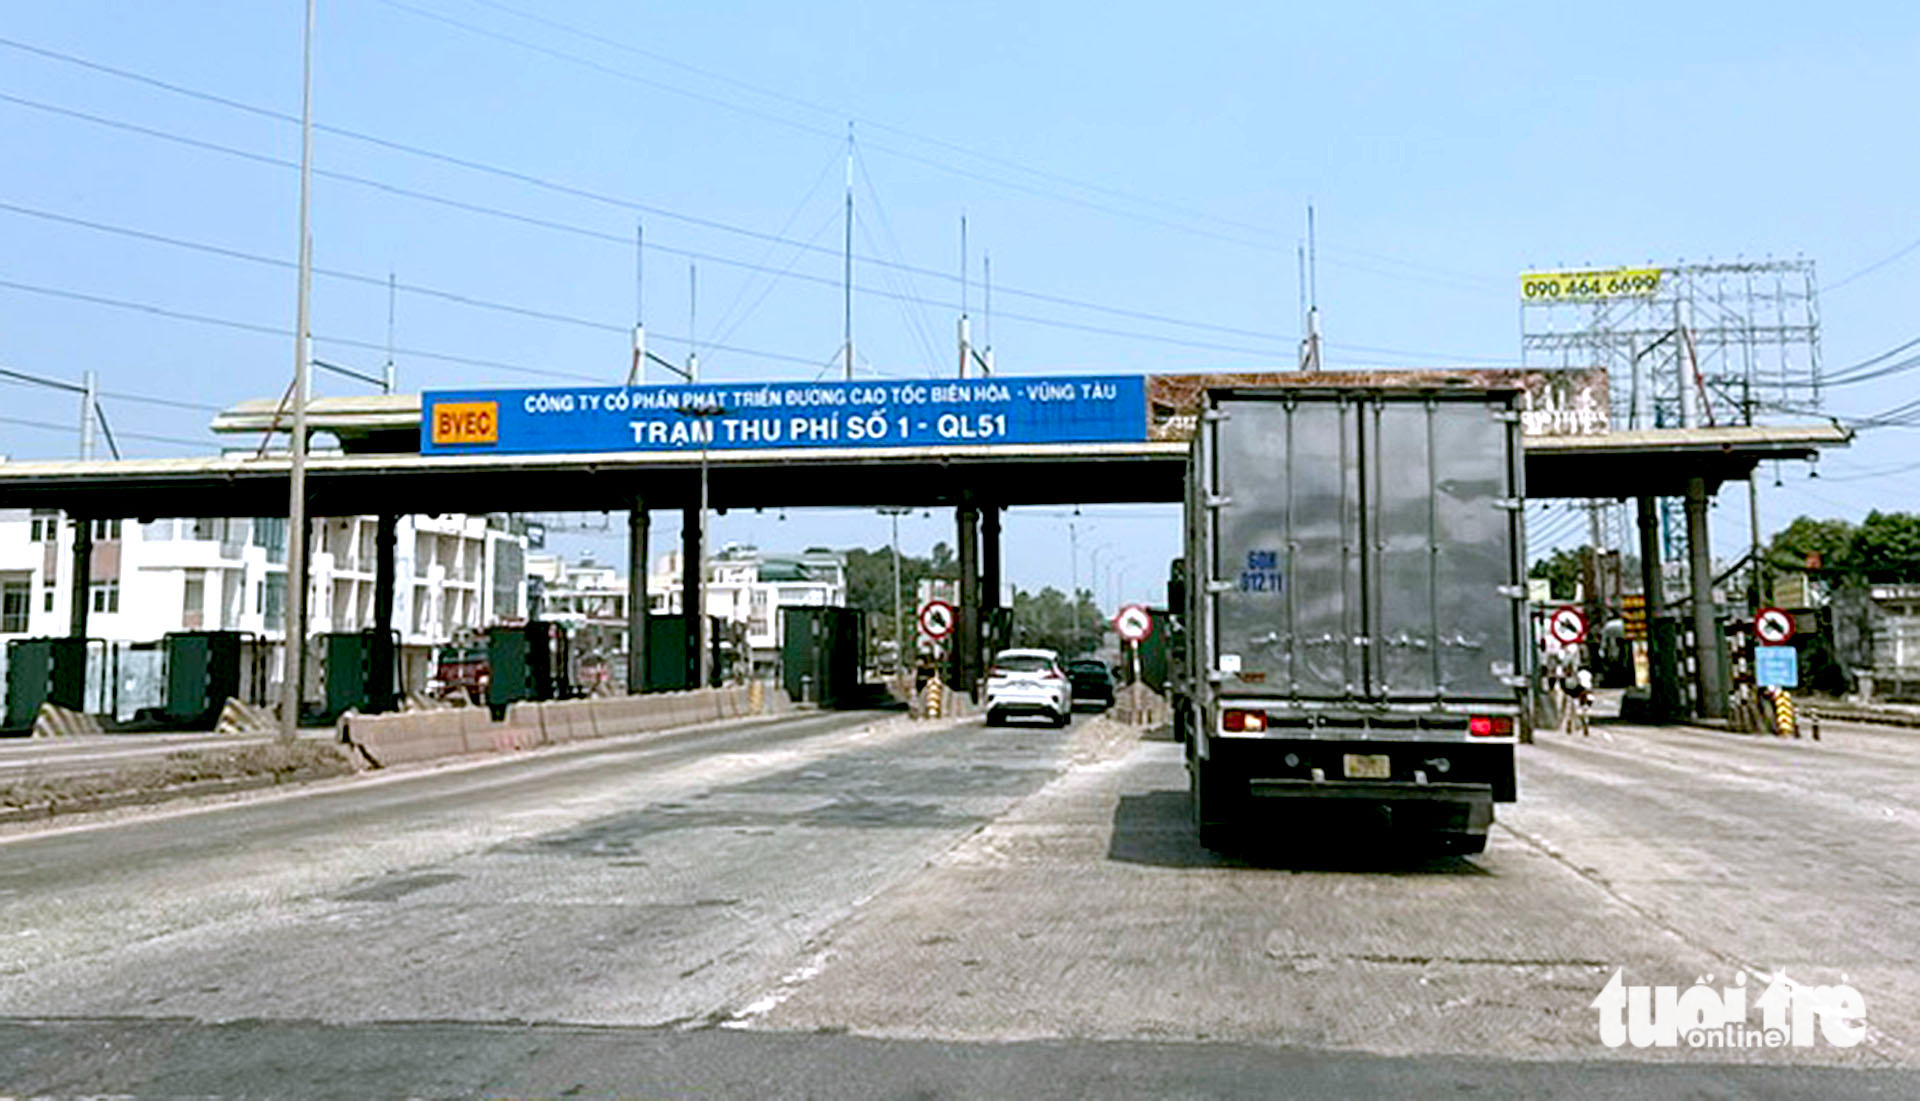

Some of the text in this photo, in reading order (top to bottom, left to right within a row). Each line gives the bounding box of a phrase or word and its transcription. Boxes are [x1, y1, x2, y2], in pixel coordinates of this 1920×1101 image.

[1524, 281, 1560, 297] 090
[1565, 279, 1600, 295] 464
[1607, 275, 1656, 293] 6699
[524, 391, 575, 413] CÔNG
[578, 394, 600, 411] TY
[682, 389, 726, 408] PHÁT
[850, 387, 887, 405] CAO
[892, 382, 928, 405] TỐC
[931, 383, 971, 403] BIÊN
[1026, 381, 1076, 401] VŨNG
[1081, 381, 1117, 400] TÀU
[439, 411, 491, 435] BVEC
[629, 420, 714, 447] TRẠM
[722, 418, 781, 442] THU
[790, 411, 839, 441] PHÍ
[847, 408, 888, 440] SỐ
[898, 415, 909, 439] 1
[938, 413, 1006, 438] QL51
